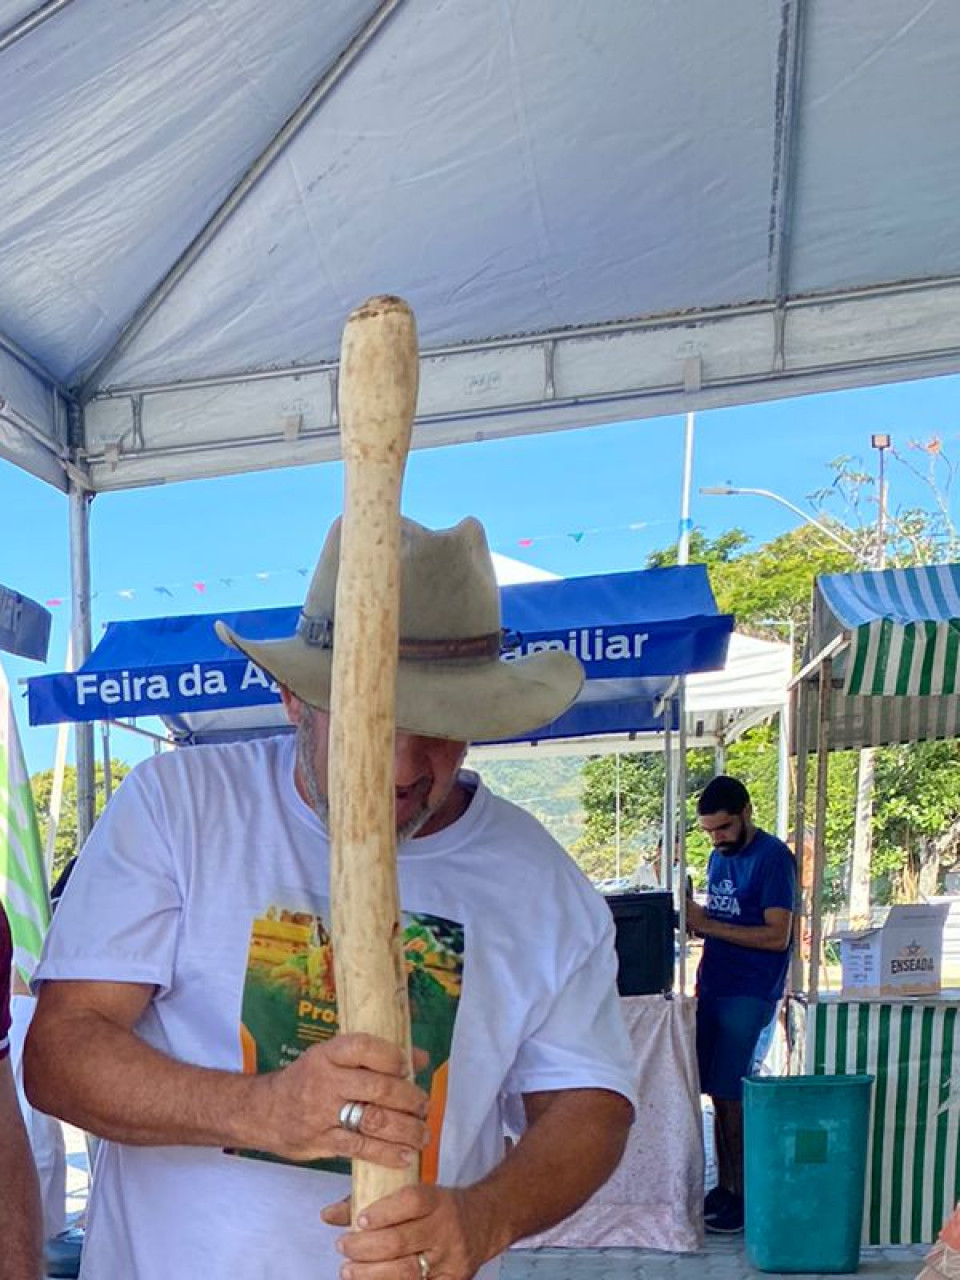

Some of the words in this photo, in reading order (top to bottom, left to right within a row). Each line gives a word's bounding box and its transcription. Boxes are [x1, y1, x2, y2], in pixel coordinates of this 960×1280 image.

[76, 671, 170, 705] Feira
[178, 664, 227, 697] da
[240, 660, 281, 693] A
[499, 628, 649, 664] amiliar
[890, 957, 935, 975] ENSEADA
[299, 1000, 336, 1024] Pro
